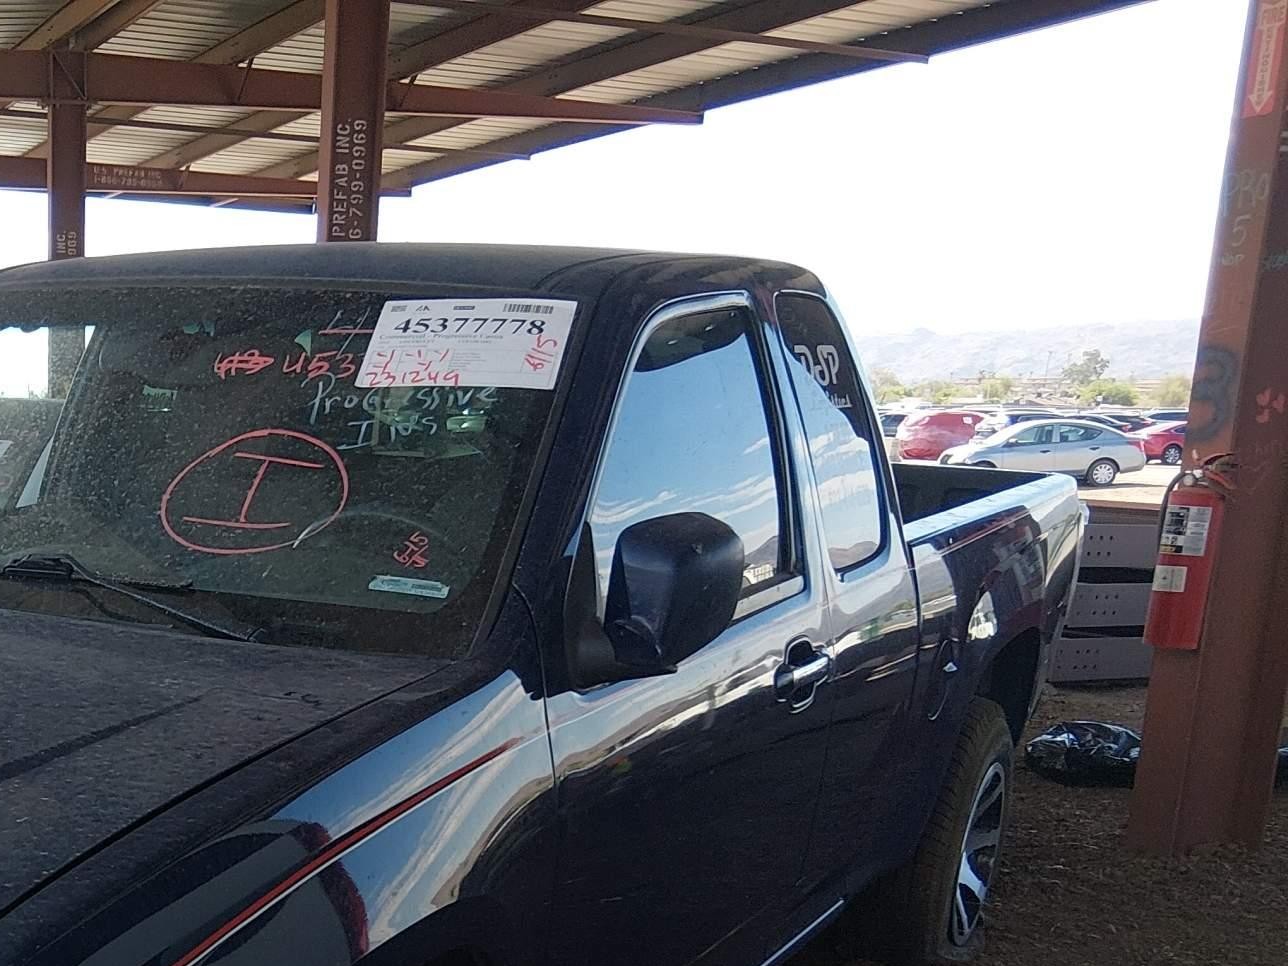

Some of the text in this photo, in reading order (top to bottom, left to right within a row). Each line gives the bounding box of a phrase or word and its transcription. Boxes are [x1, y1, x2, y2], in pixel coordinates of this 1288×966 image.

[332, 118, 351, 236] PREFAB INC.
[394, 317, 547, 336] 45377778
